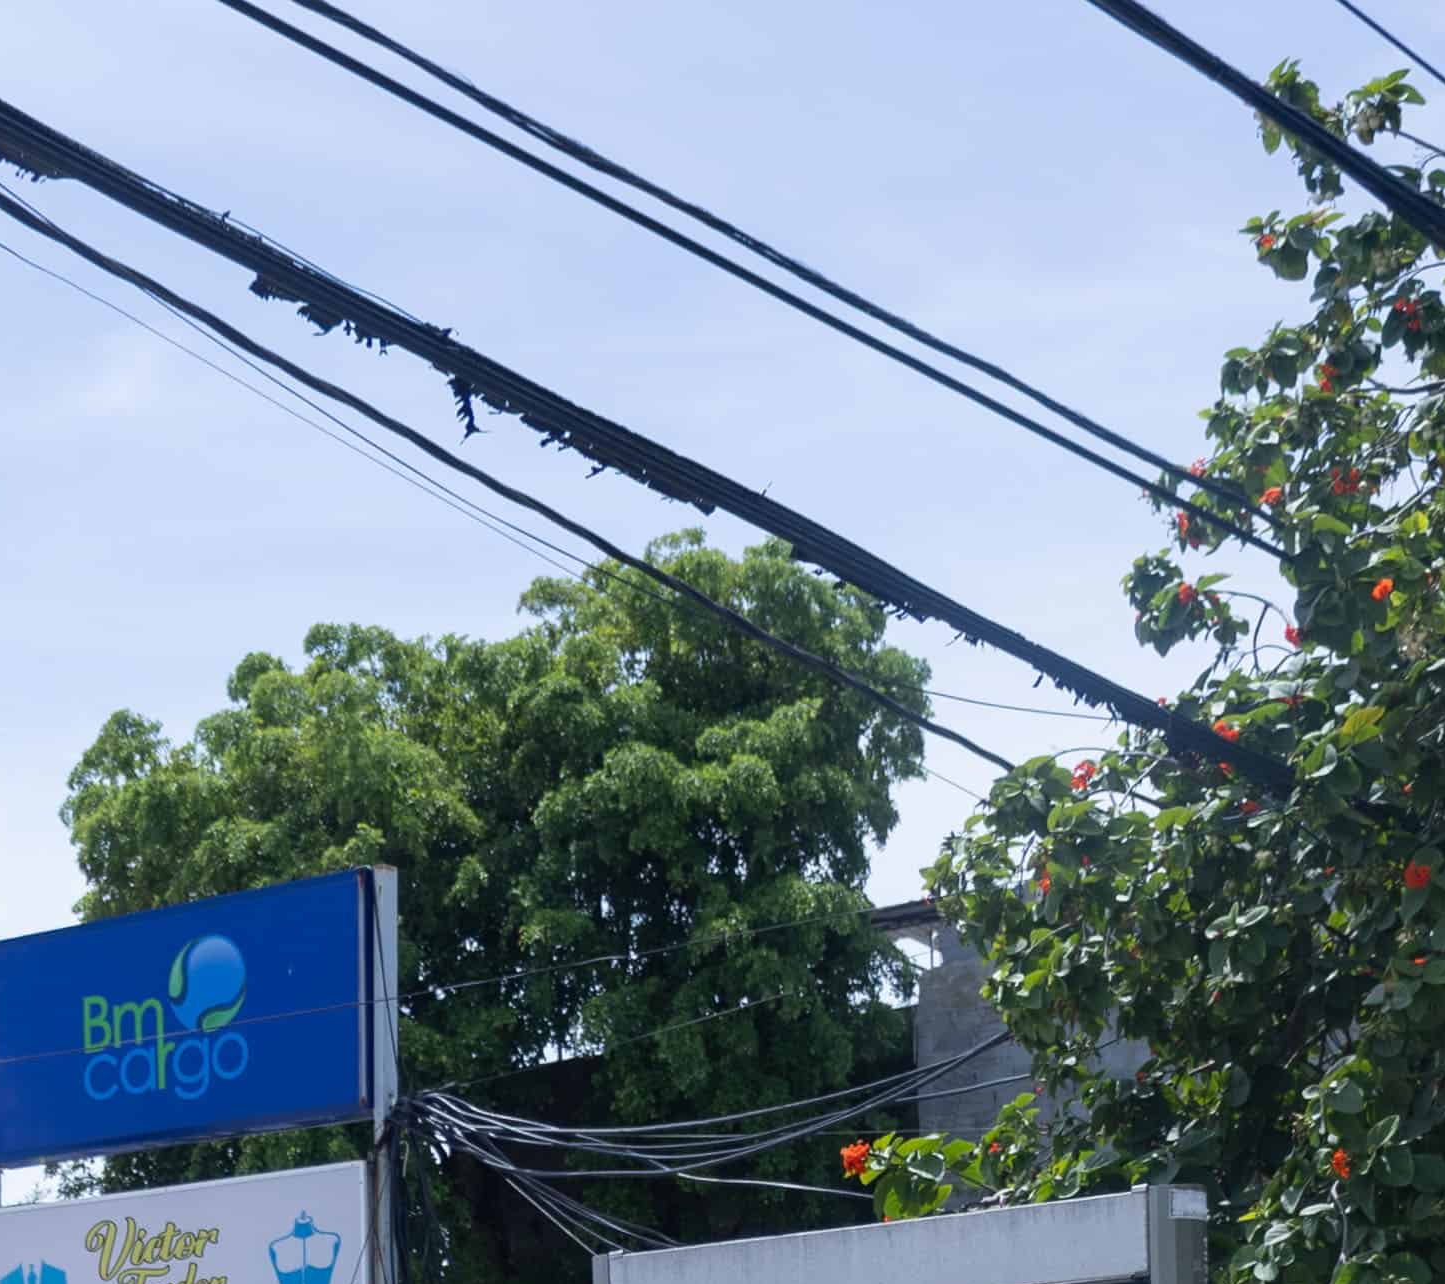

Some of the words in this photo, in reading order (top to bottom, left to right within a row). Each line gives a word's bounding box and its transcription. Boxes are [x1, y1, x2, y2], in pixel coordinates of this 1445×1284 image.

[83, 995, 164, 1053] Bm
[84, 1032, 249, 1100] cargo
[85, 1216, 220, 1281] Victor
